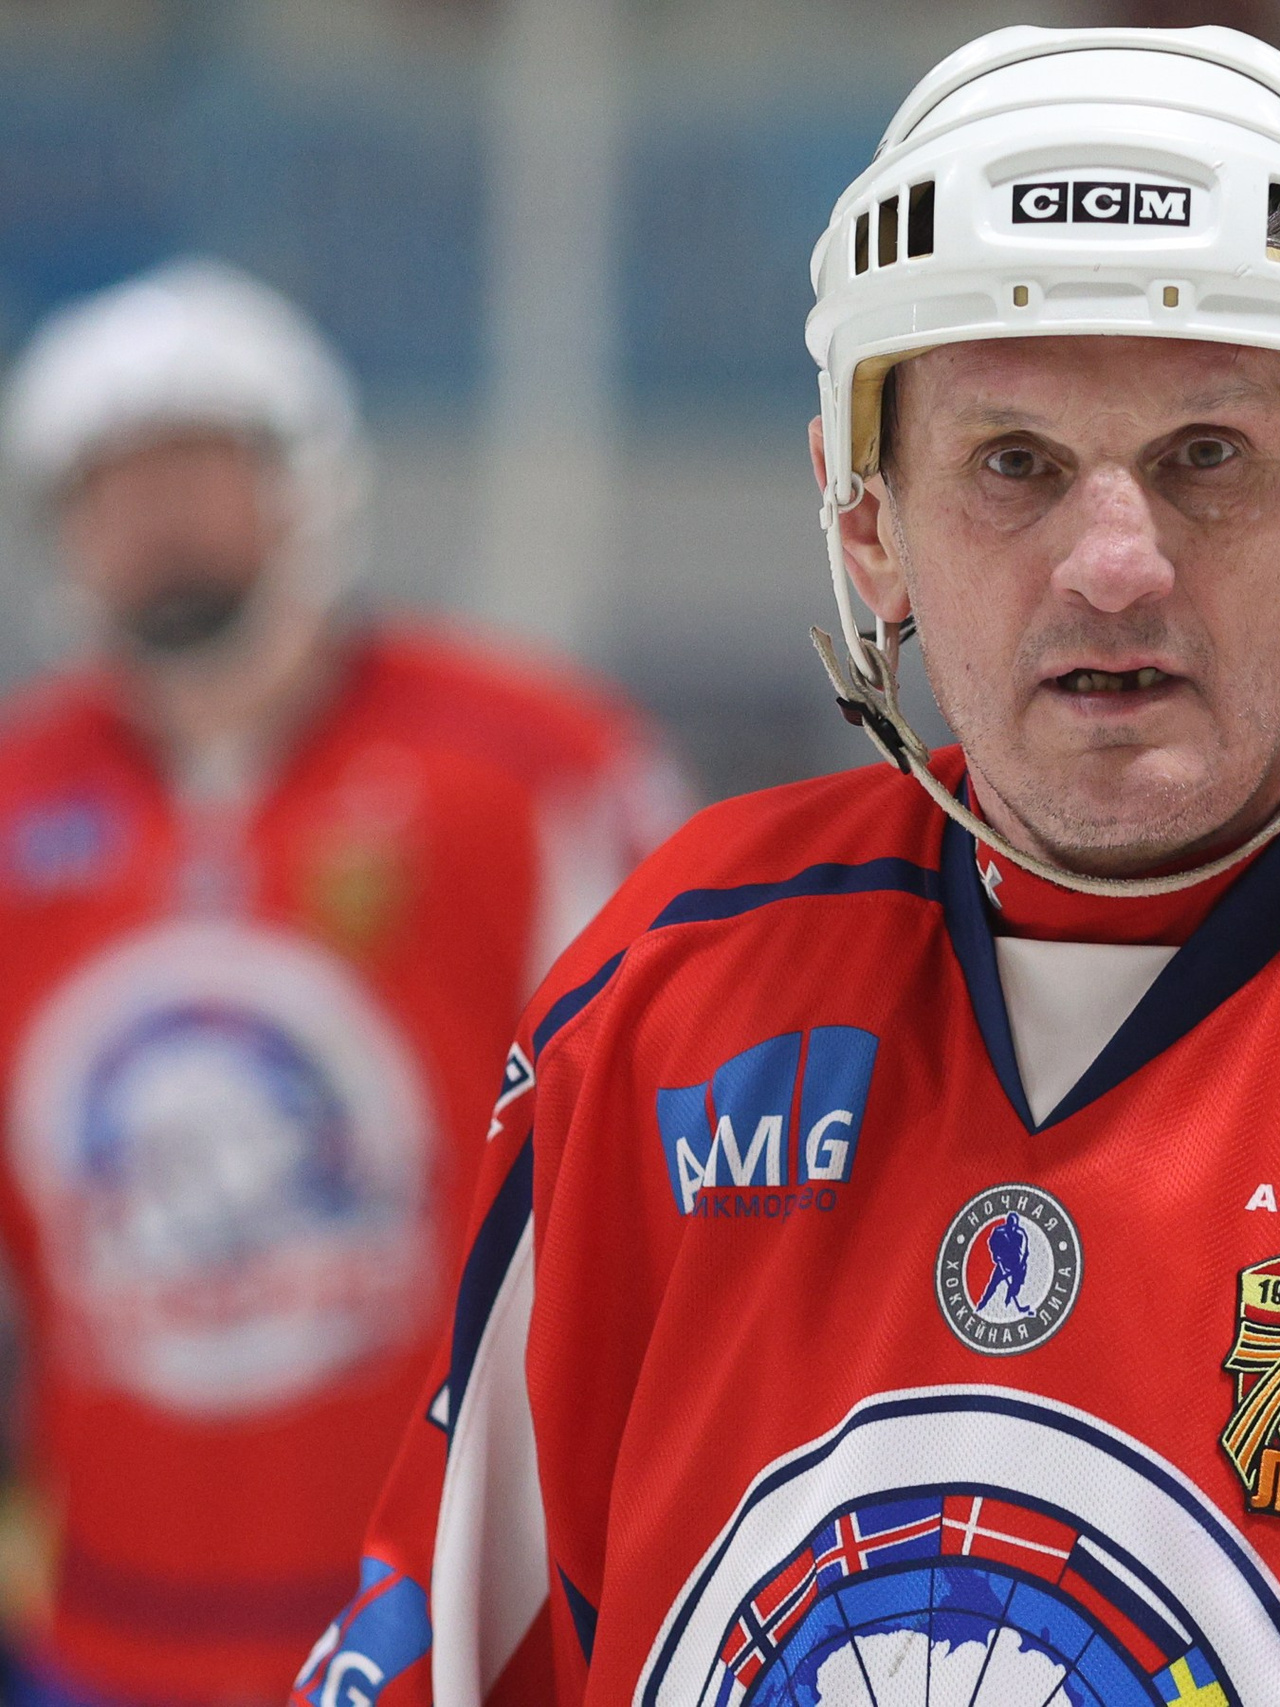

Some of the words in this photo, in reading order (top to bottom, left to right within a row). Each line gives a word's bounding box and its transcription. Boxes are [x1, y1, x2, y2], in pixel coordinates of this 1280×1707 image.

[1018, 186, 1187, 221] CCM
[676, 1109, 854, 1215] AMG
[967, 1195, 1059, 1232] НОЧНАЯ
[946, 1260, 1029, 1343] ХОККЕЙНАЯ
[1038, 1266, 1072, 1326] ЛИГА
